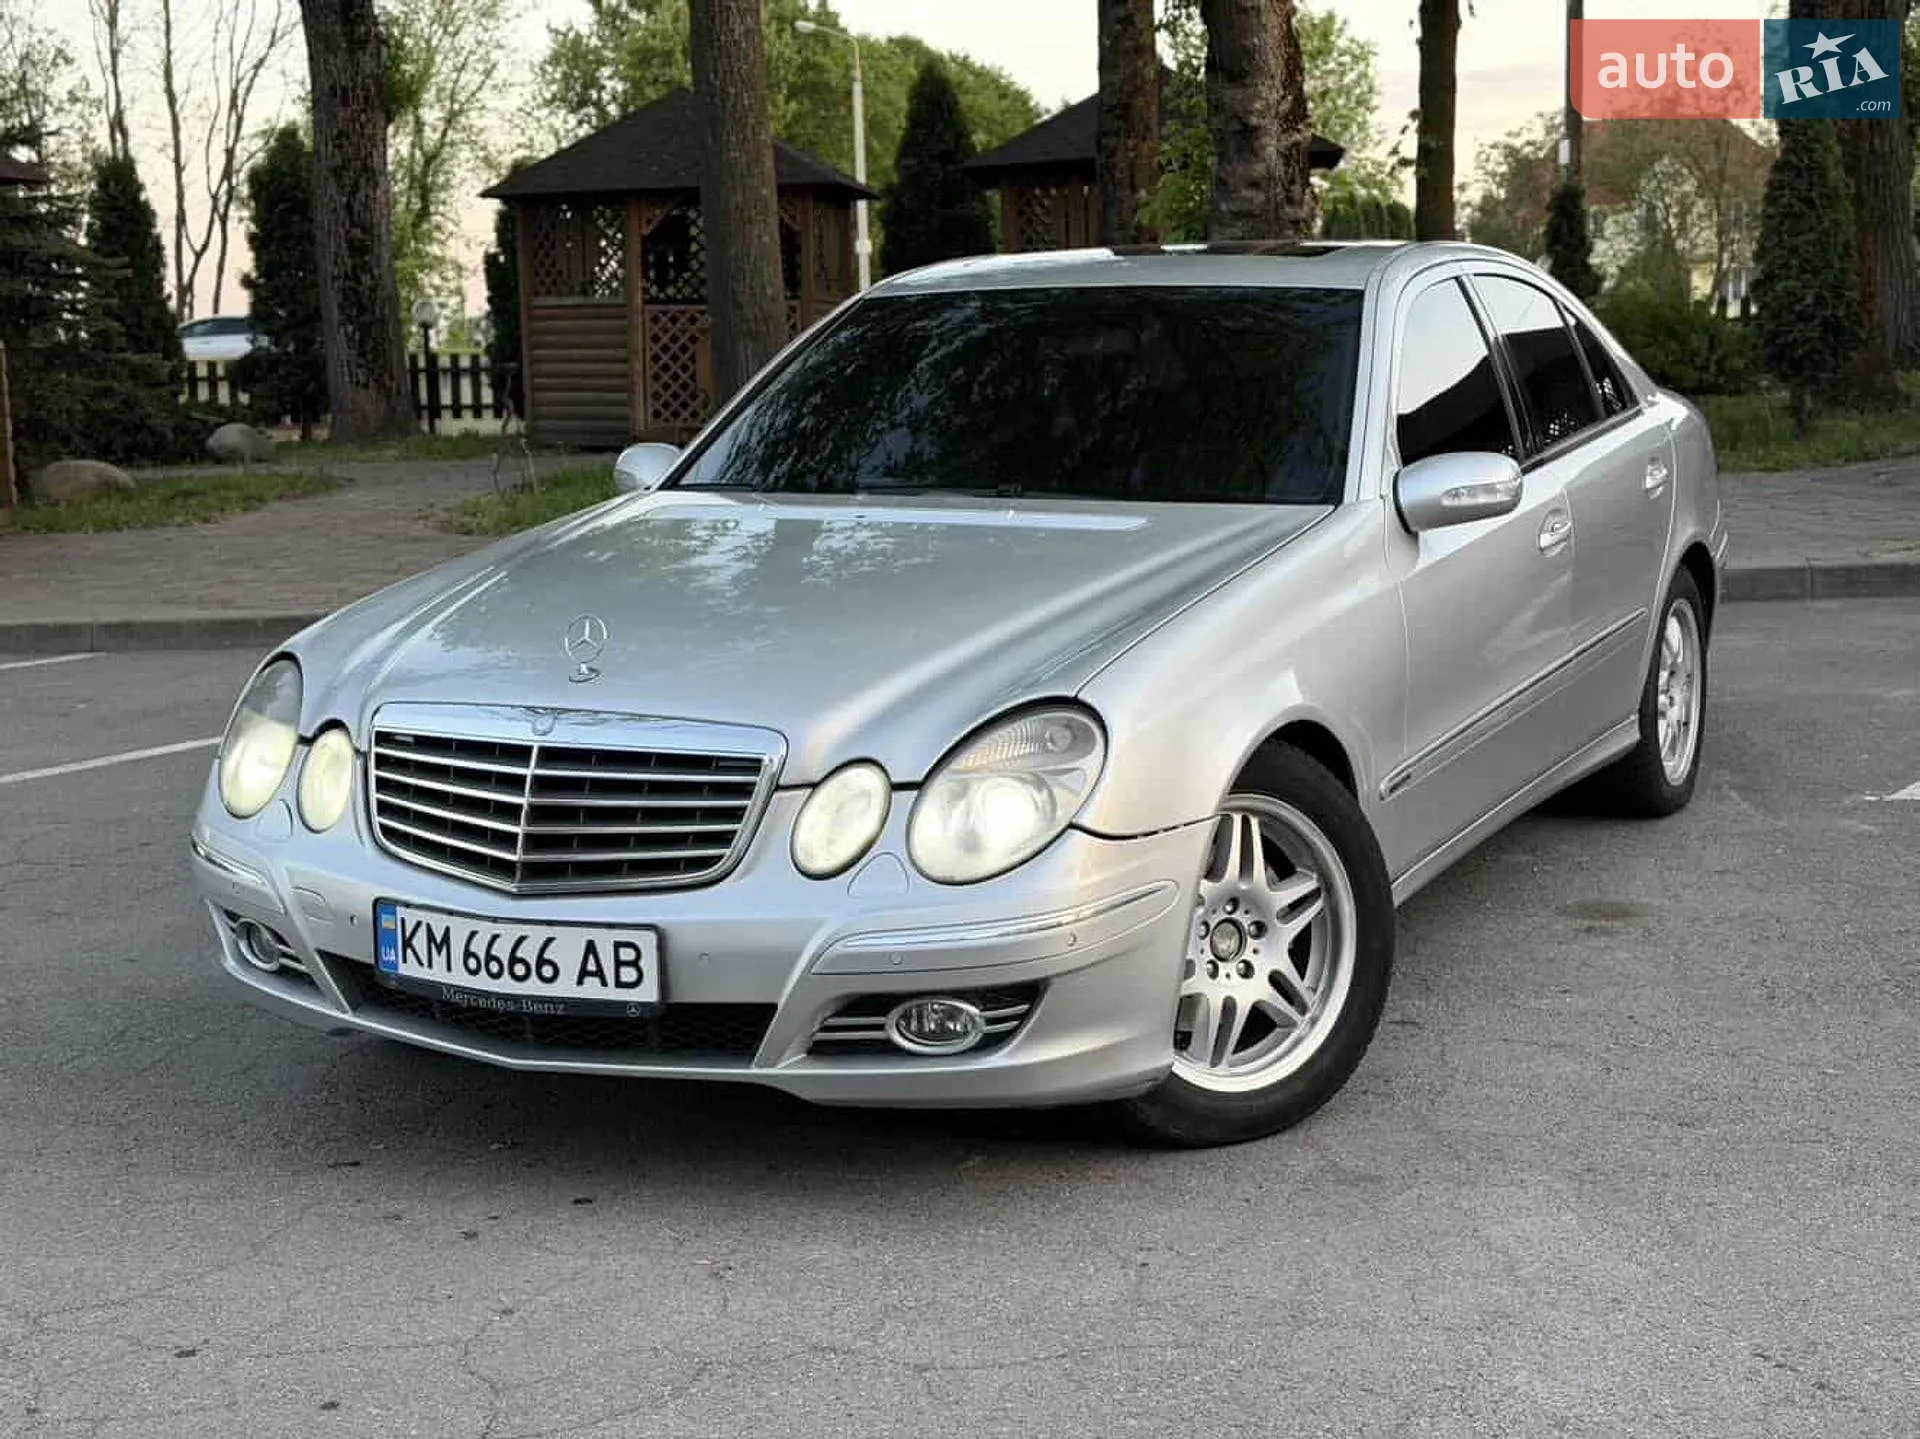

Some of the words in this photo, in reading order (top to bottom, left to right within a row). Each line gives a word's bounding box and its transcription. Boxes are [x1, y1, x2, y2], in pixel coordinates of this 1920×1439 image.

[382, 943, 396, 962] UA
[400, 916, 452, 973] KM
[462, 929, 561, 984] 6666
[575, 939, 645, 990] AB
